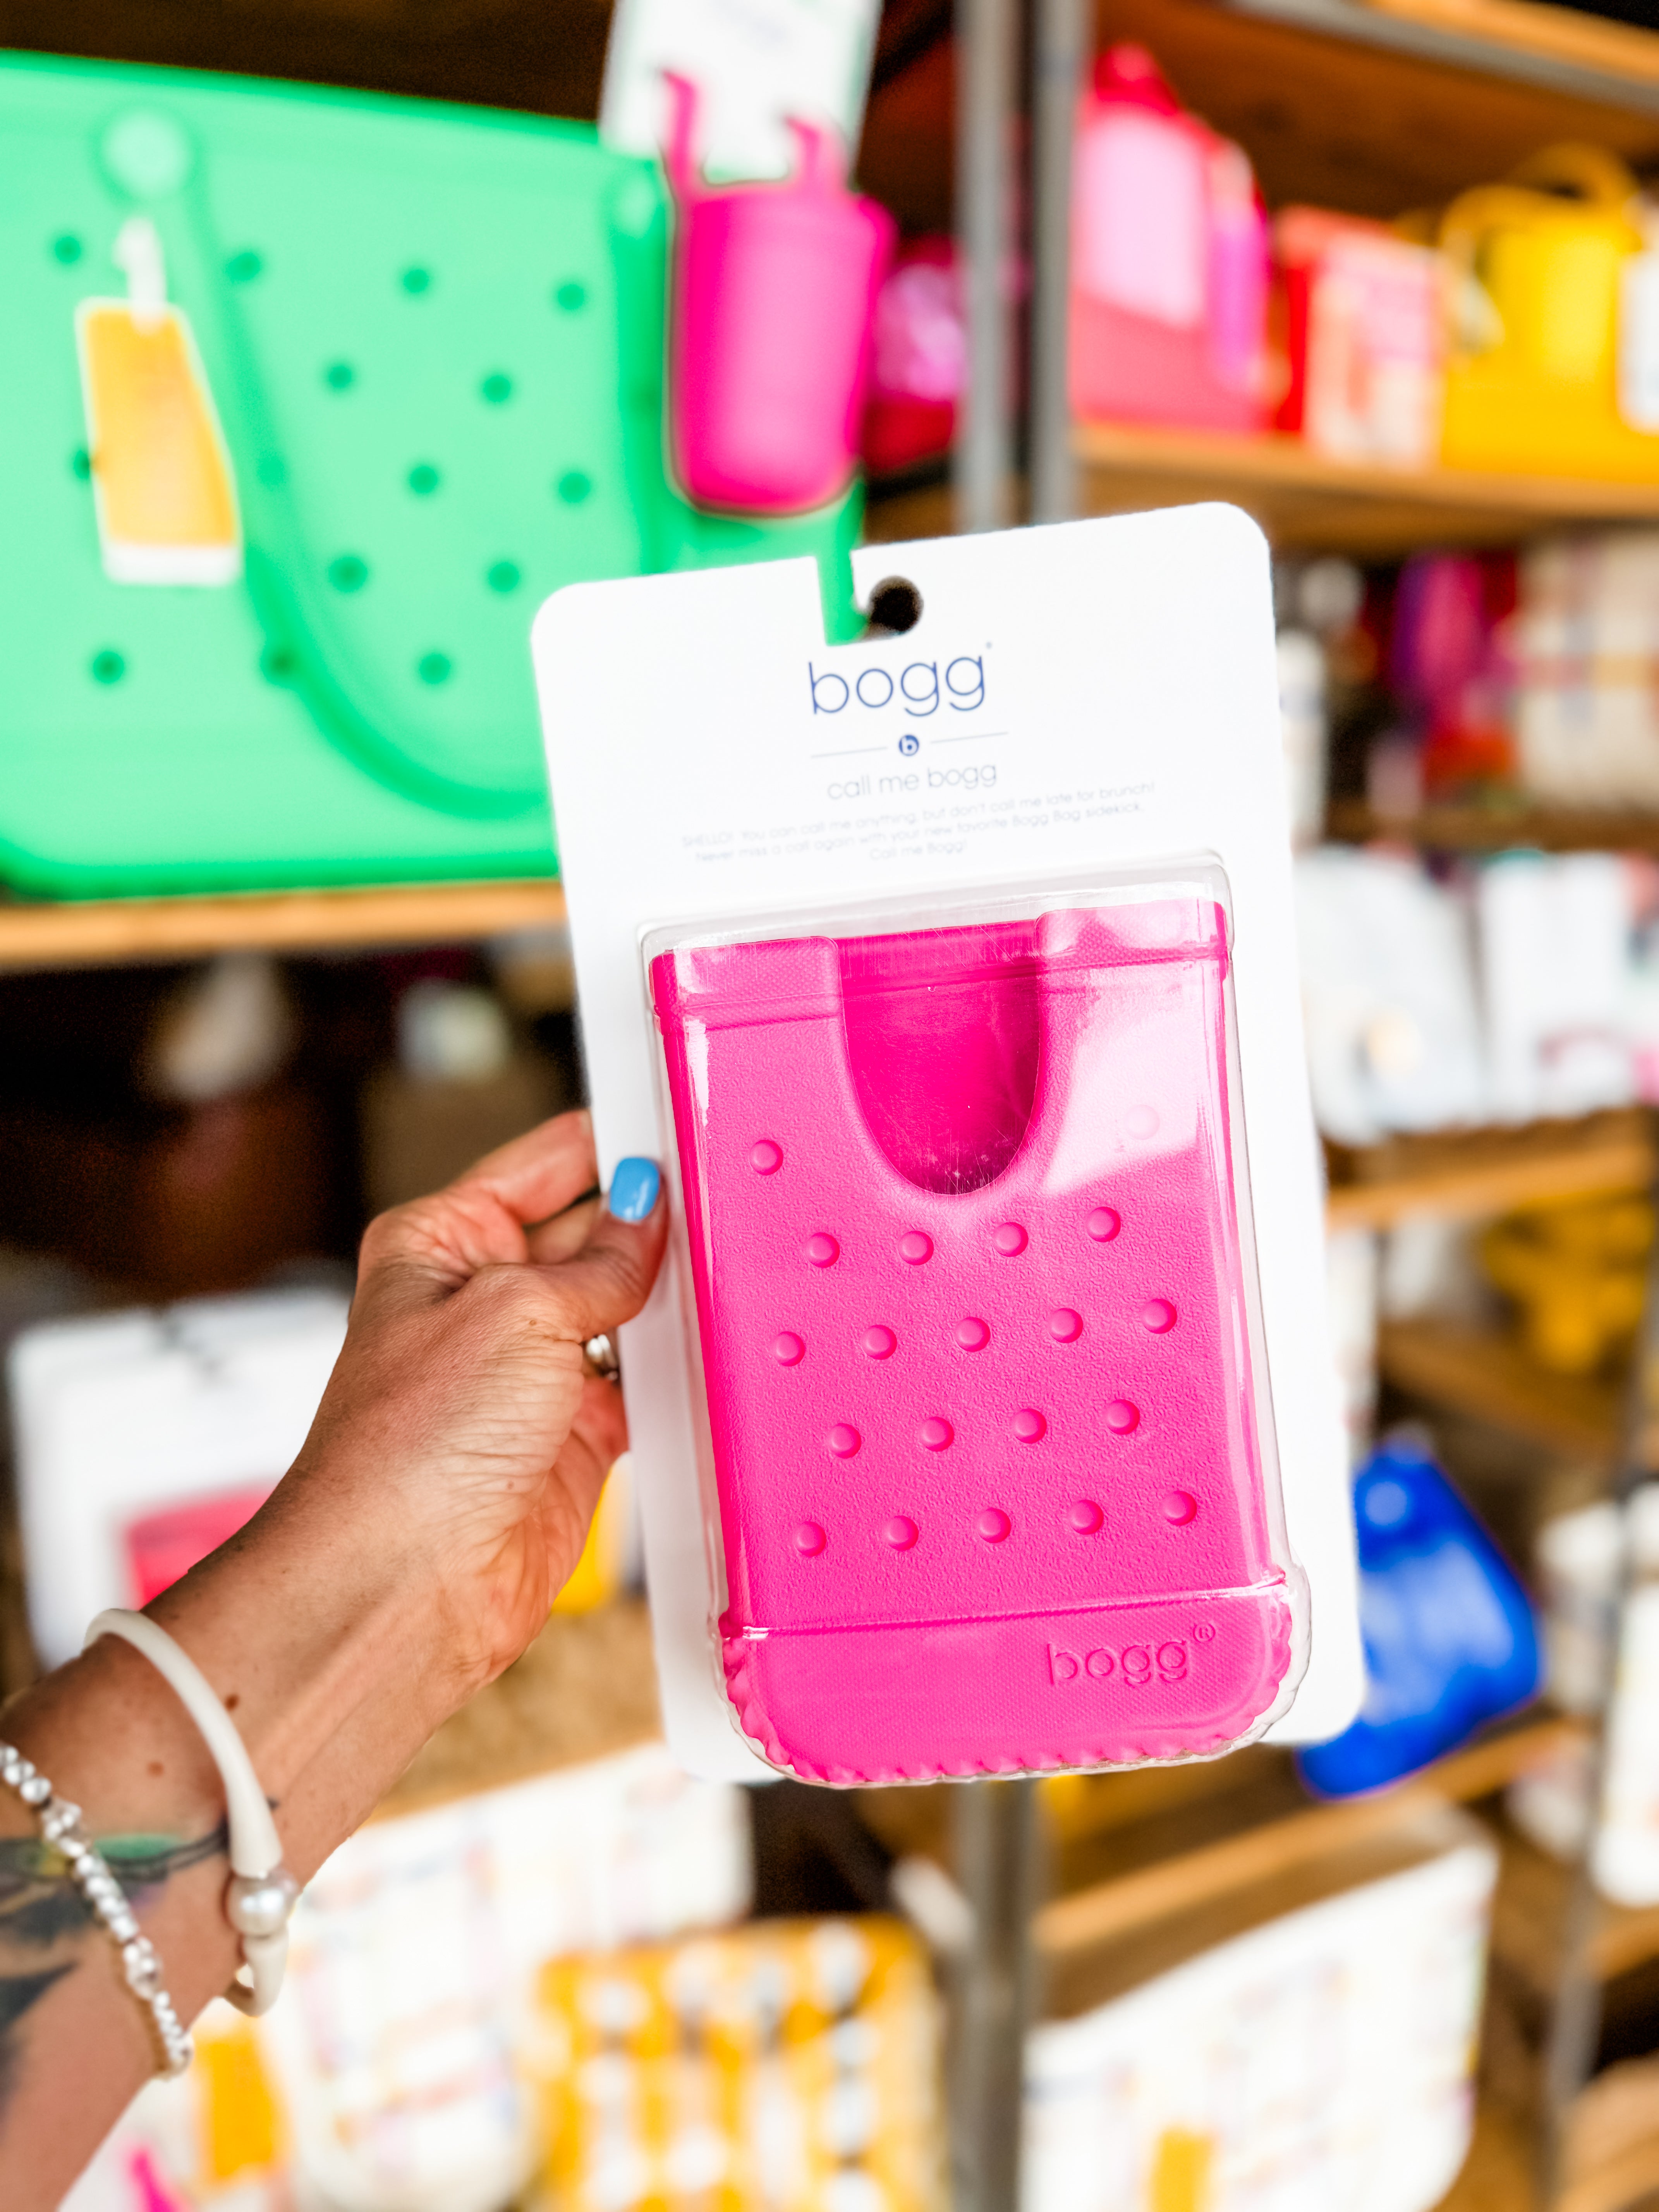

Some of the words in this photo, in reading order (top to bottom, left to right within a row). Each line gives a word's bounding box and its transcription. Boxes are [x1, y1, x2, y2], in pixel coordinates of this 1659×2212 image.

[808, 654, 986, 718] bogg
[828, 774, 871, 800] call
[879, 773, 920, 794] me
[927, 764, 997, 790] bogg
[696, 849, 733, 862] Never
[739, 847, 767, 858] miss
[771, 845, 781, 855] a
[786, 840, 809, 854] call
[814, 836, 855, 852] again
[859, 831, 886, 844] with
[891, 830, 919, 842] your
[925, 827, 952, 836] new
[957, 818, 1008, 833] favorite
[1012, 814, 1049, 828] Bogg
[1053, 810, 1080, 822] Bag
[742, 830, 765, 841] You
[769, 826, 796, 838] can
[800, 821, 825, 835] call
[829, 820, 851, 830] me
[923, 808, 945, 821] but
[950, 803, 985, 817] don't
[990, 799, 1015, 812] call
[1020, 798, 1041, 808] me
[1046, 793, 1072, 805] late
[1077, 790, 1095, 801] for
[1100, 781, 1155, 799] brunch!
[870, 847, 897, 860] Call
[901, 845, 922, 857] me
[927, 838, 967, 854] Bogg!
